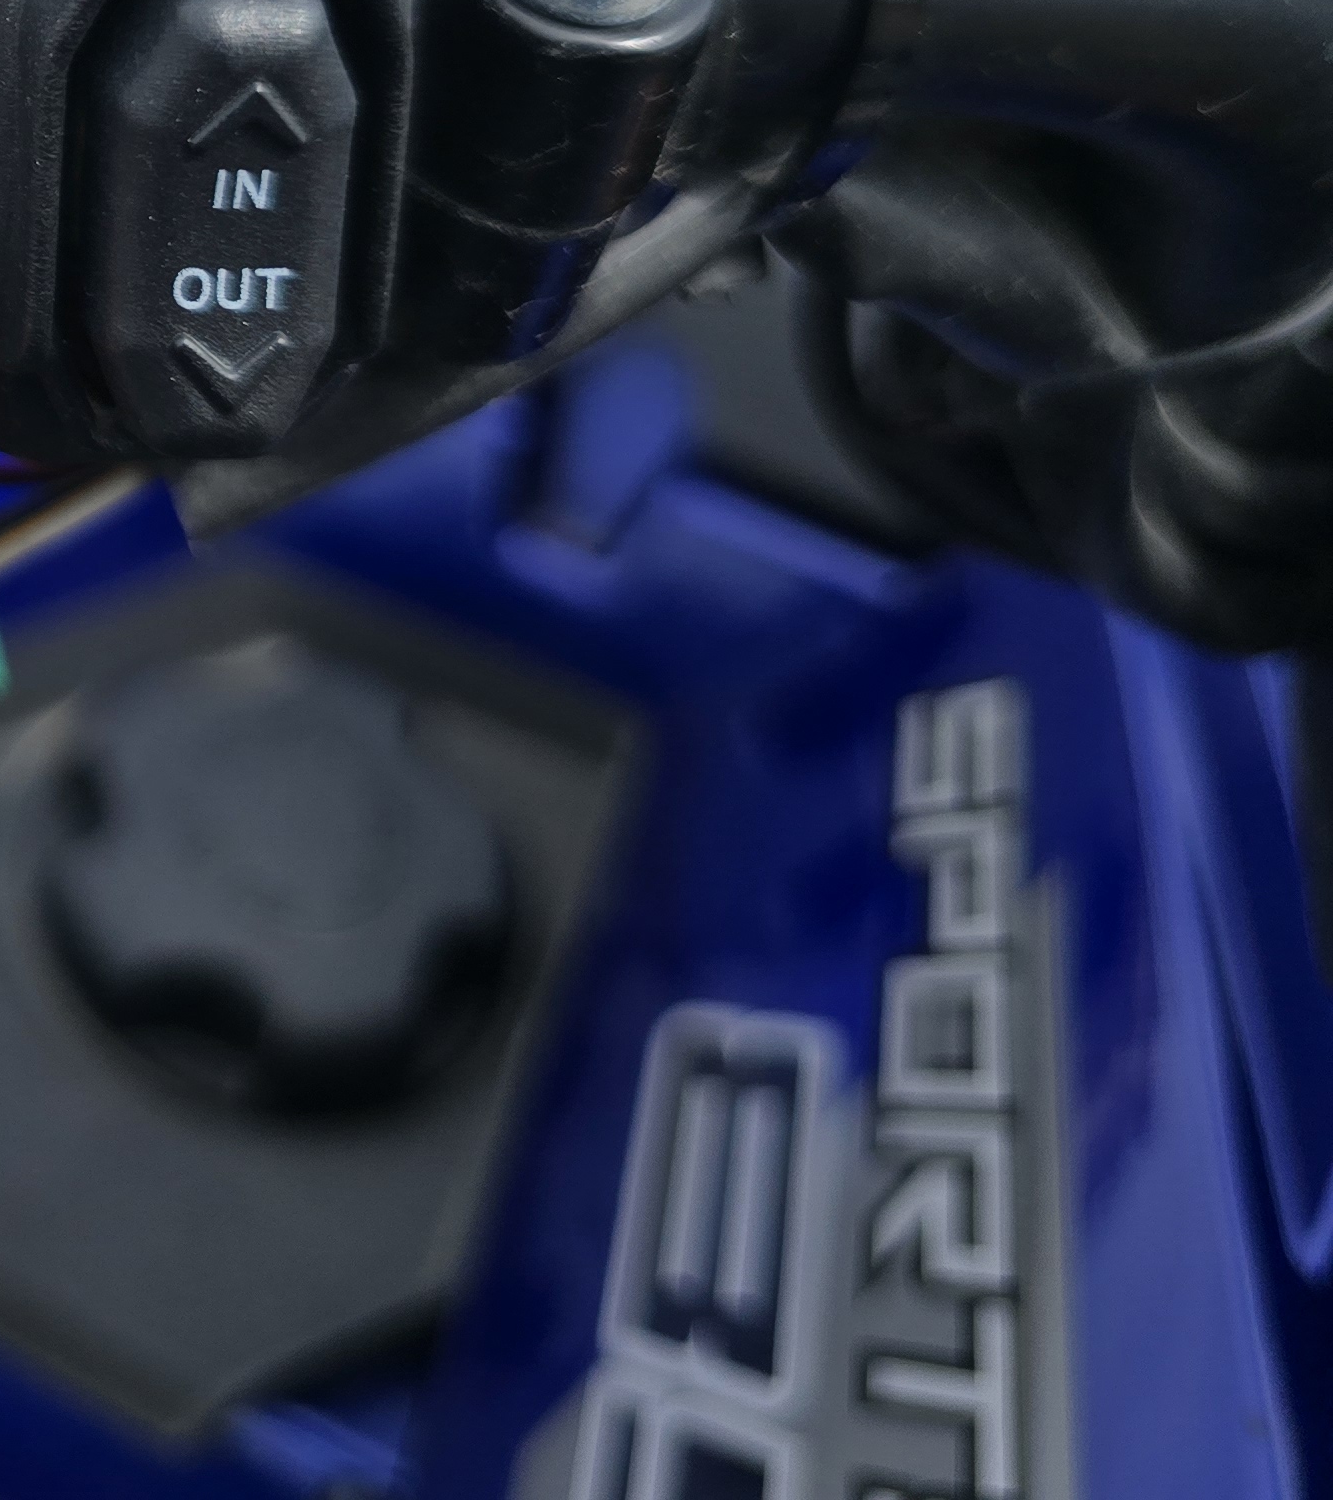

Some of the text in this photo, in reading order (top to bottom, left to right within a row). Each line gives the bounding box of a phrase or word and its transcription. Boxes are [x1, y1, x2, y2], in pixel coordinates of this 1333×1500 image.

[213, 168, 277, 211] IN
[172, 266, 295, 312] OUT
[858, 672, 1035, 1500] SPORT
